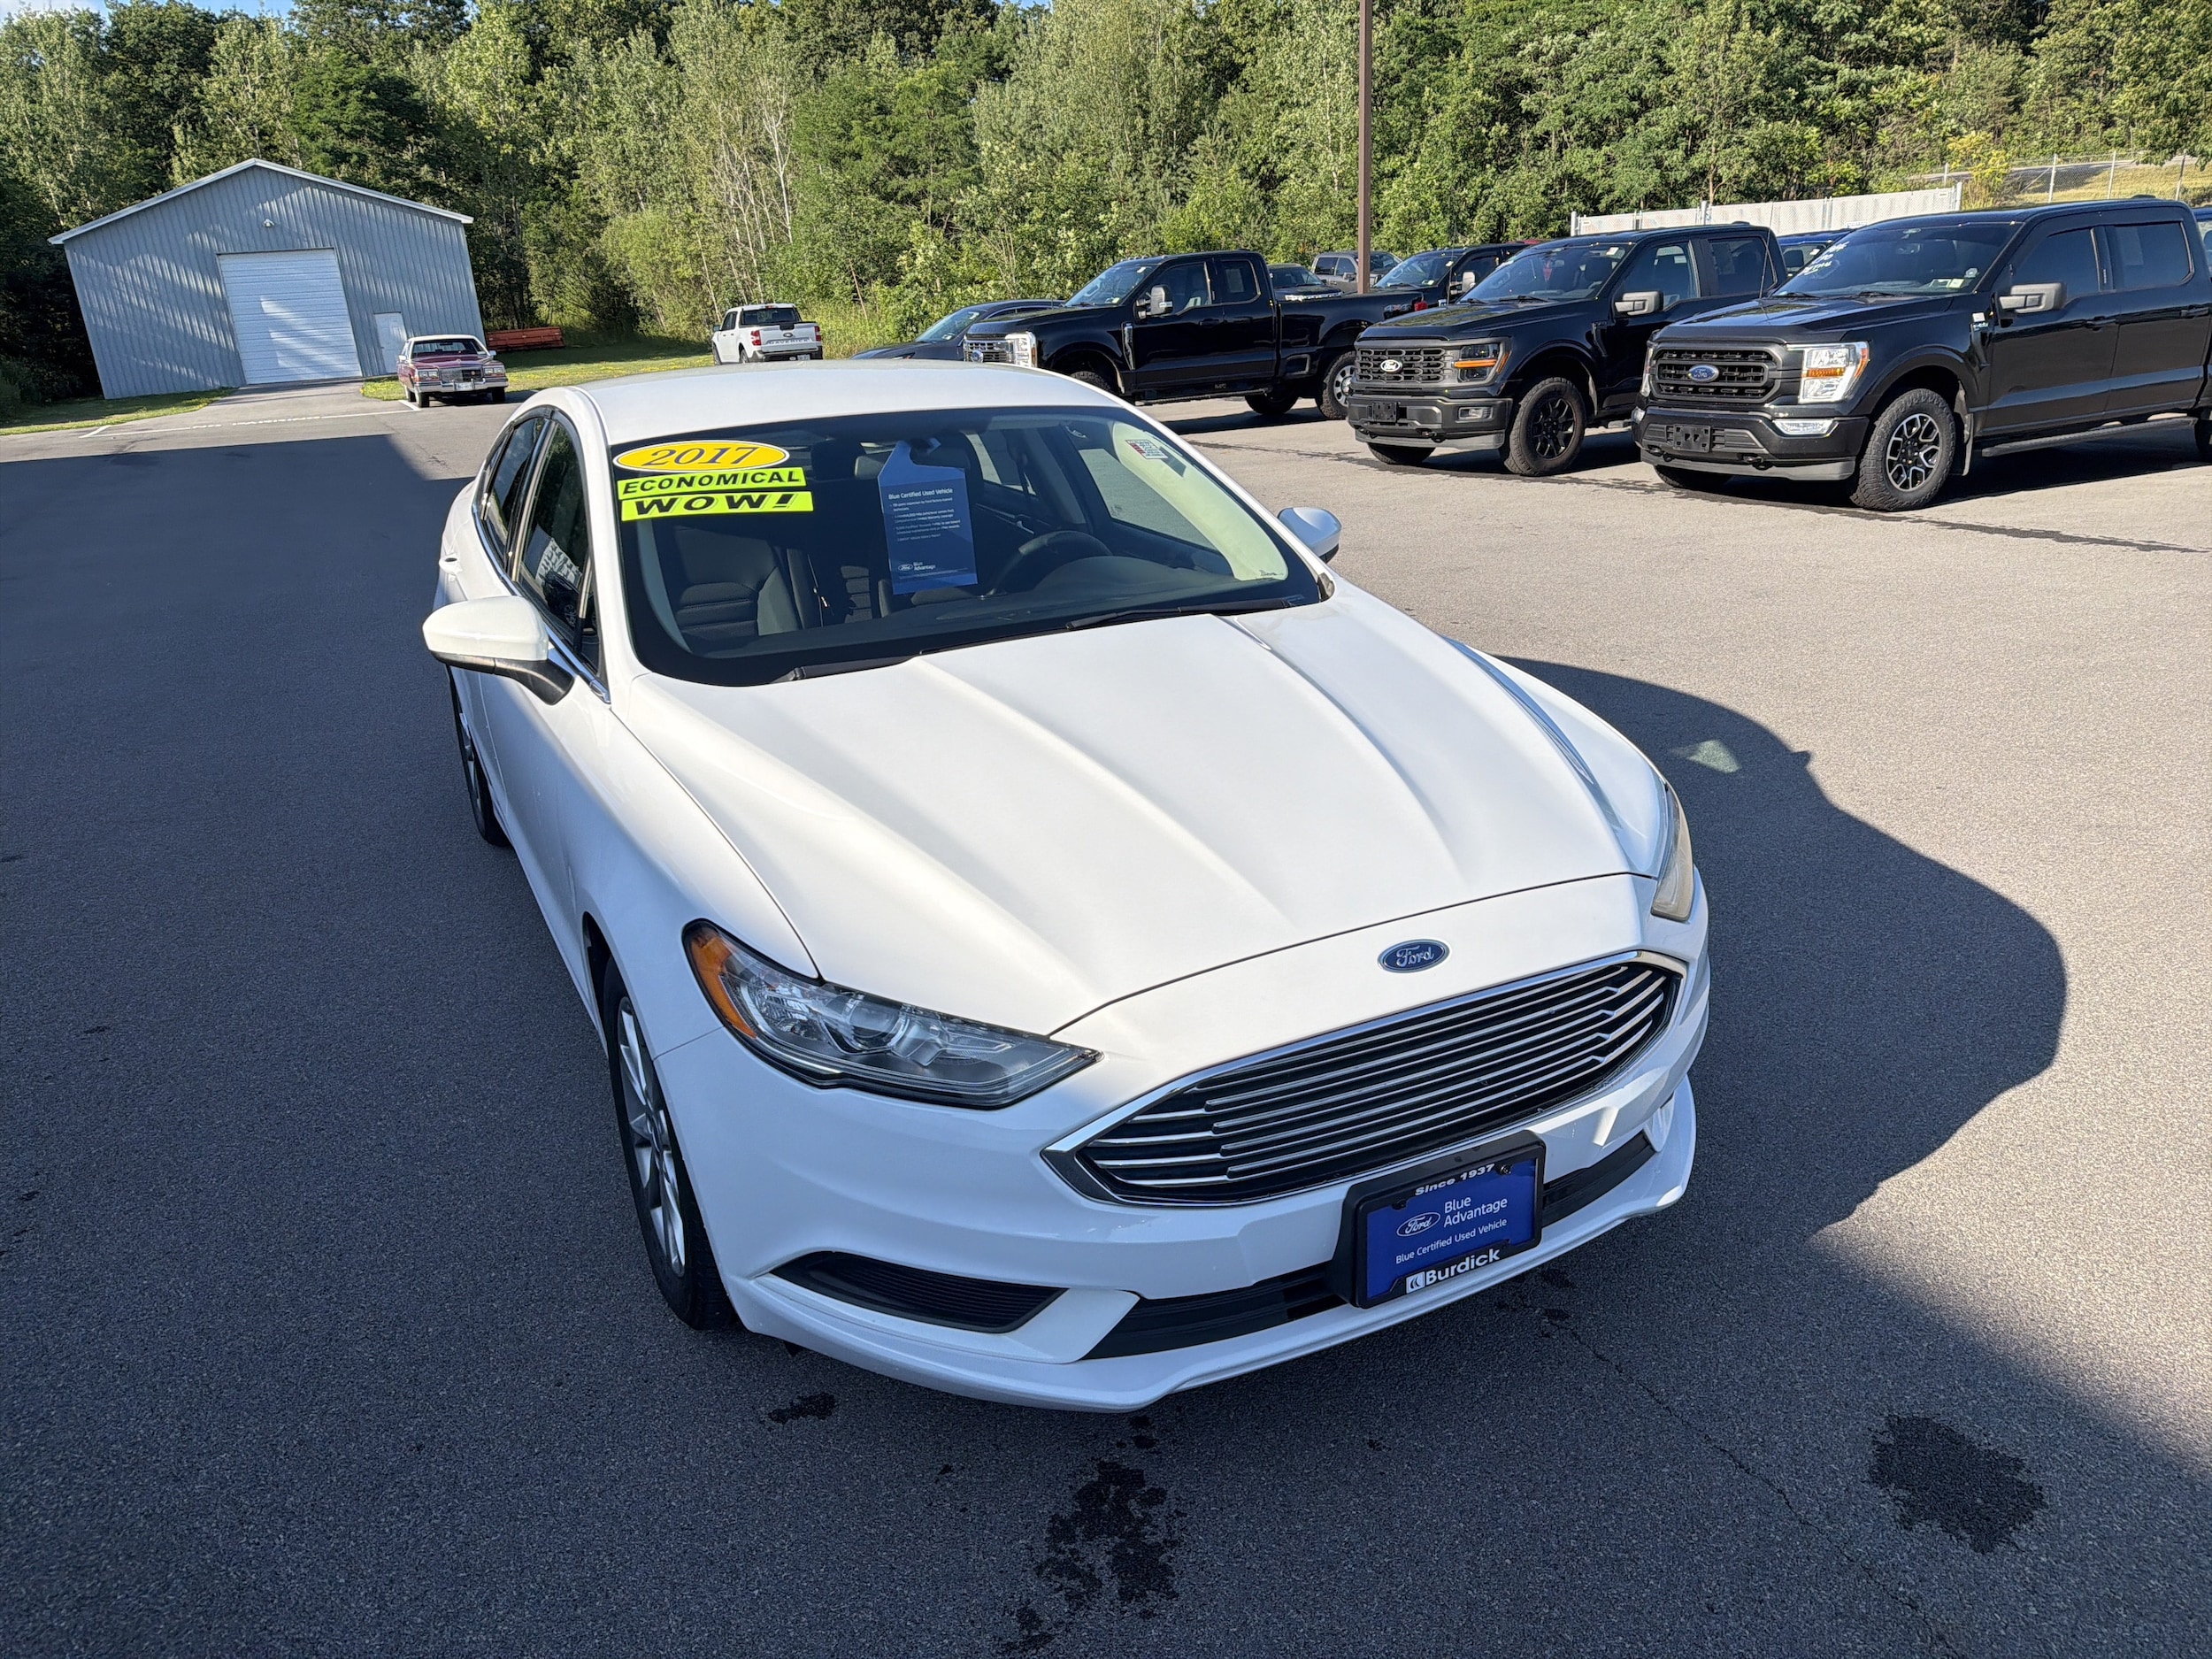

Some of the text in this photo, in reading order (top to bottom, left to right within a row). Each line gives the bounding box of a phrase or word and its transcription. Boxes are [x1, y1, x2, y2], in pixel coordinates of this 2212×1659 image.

[641, 447, 761, 466] 2017
[622, 470, 802, 495] ECONOMICAL
[634, 493, 800, 516] WOW!
[1396, 945, 1435, 967] Ford
[1414, 1163, 1495, 1196] Since 1937
[1443, 1198, 1508, 1228] Advantage
[1444, 1196, 1471, 1214] Blue
[1403, 1213, 1434, 1235] Ford
[1395, 1217, 1508, 1265] Blue Certified Used Vehicle
[1425, 1248, 1500, 1285] Burdick
